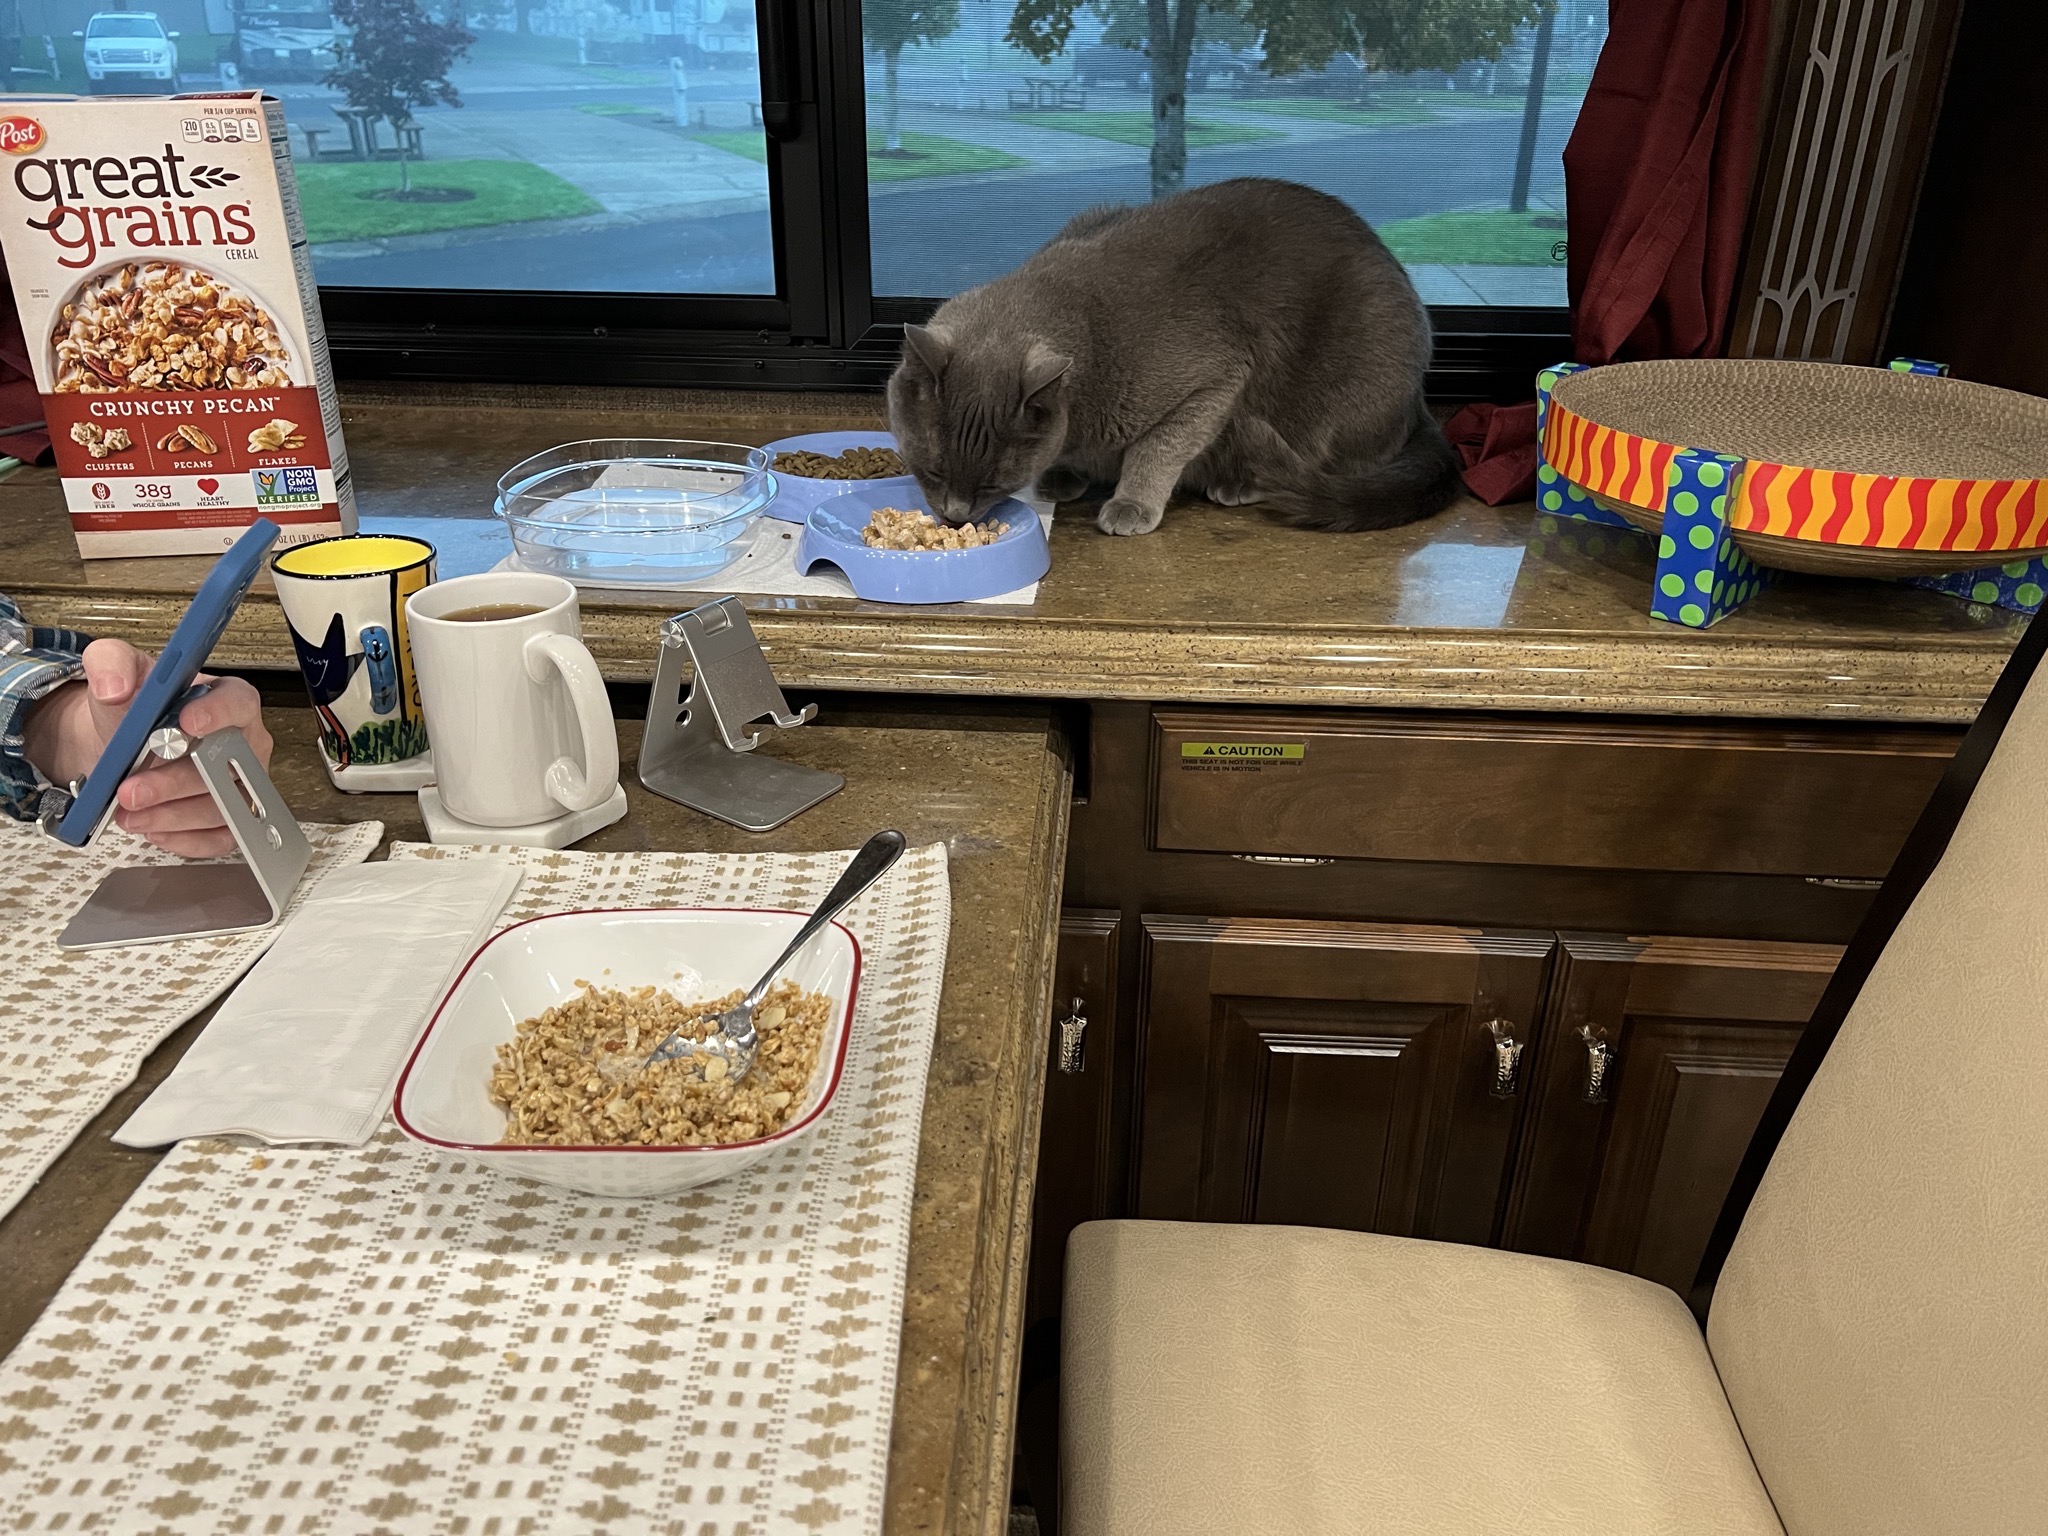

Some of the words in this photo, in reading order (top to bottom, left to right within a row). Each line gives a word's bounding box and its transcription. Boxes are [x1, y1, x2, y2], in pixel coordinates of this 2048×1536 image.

[203, 107, 214, 115] PER
[214, 107, 224, 115] 3/4
[224, 107, 234, 115] CUP
[234, 107, 257, 115] SERVING
[184, 120, 198, 131] 210
[0, 121, 37, 148] Post
[14, 143, 195, 231] great
[47, 200, 256, 269] grains
[225, 249, 259, 260] CEREAL
[89, 400, 195, 417] CRUNCHY
[173, 460, 214, 469] PECANS
[258, 456, 298, 466] FLAKES
[85, 462, 135, 471] CLUSTERS
[286, 469, 313, 478] NON
[287, 477, 315, 486] GMO
[134, 483, 172, 499] 38g
[288, 485, 316, 494] Project
[260, 493, 318, 504] VERIFIED
[258, 503, 321, 511] nongmoproject.org
[1218, 746, 1284, 756] CAUTION
